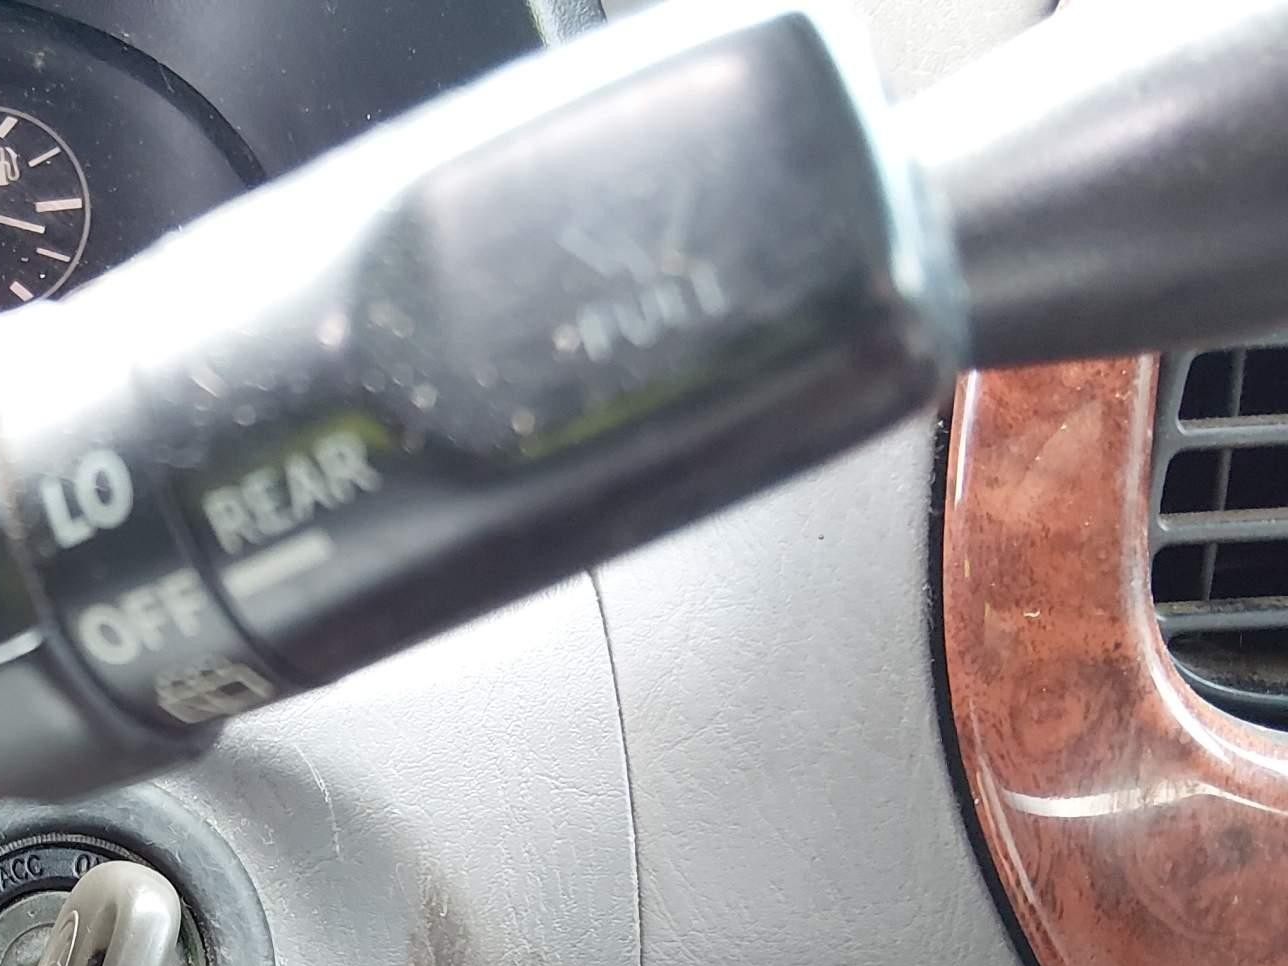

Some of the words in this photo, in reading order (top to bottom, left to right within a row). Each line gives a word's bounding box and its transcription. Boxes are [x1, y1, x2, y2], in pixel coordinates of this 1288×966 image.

[40, 448, 134, 549] LO
[202, 431, 382, 554] REAR
[78, 567, 206, 665] OFF
